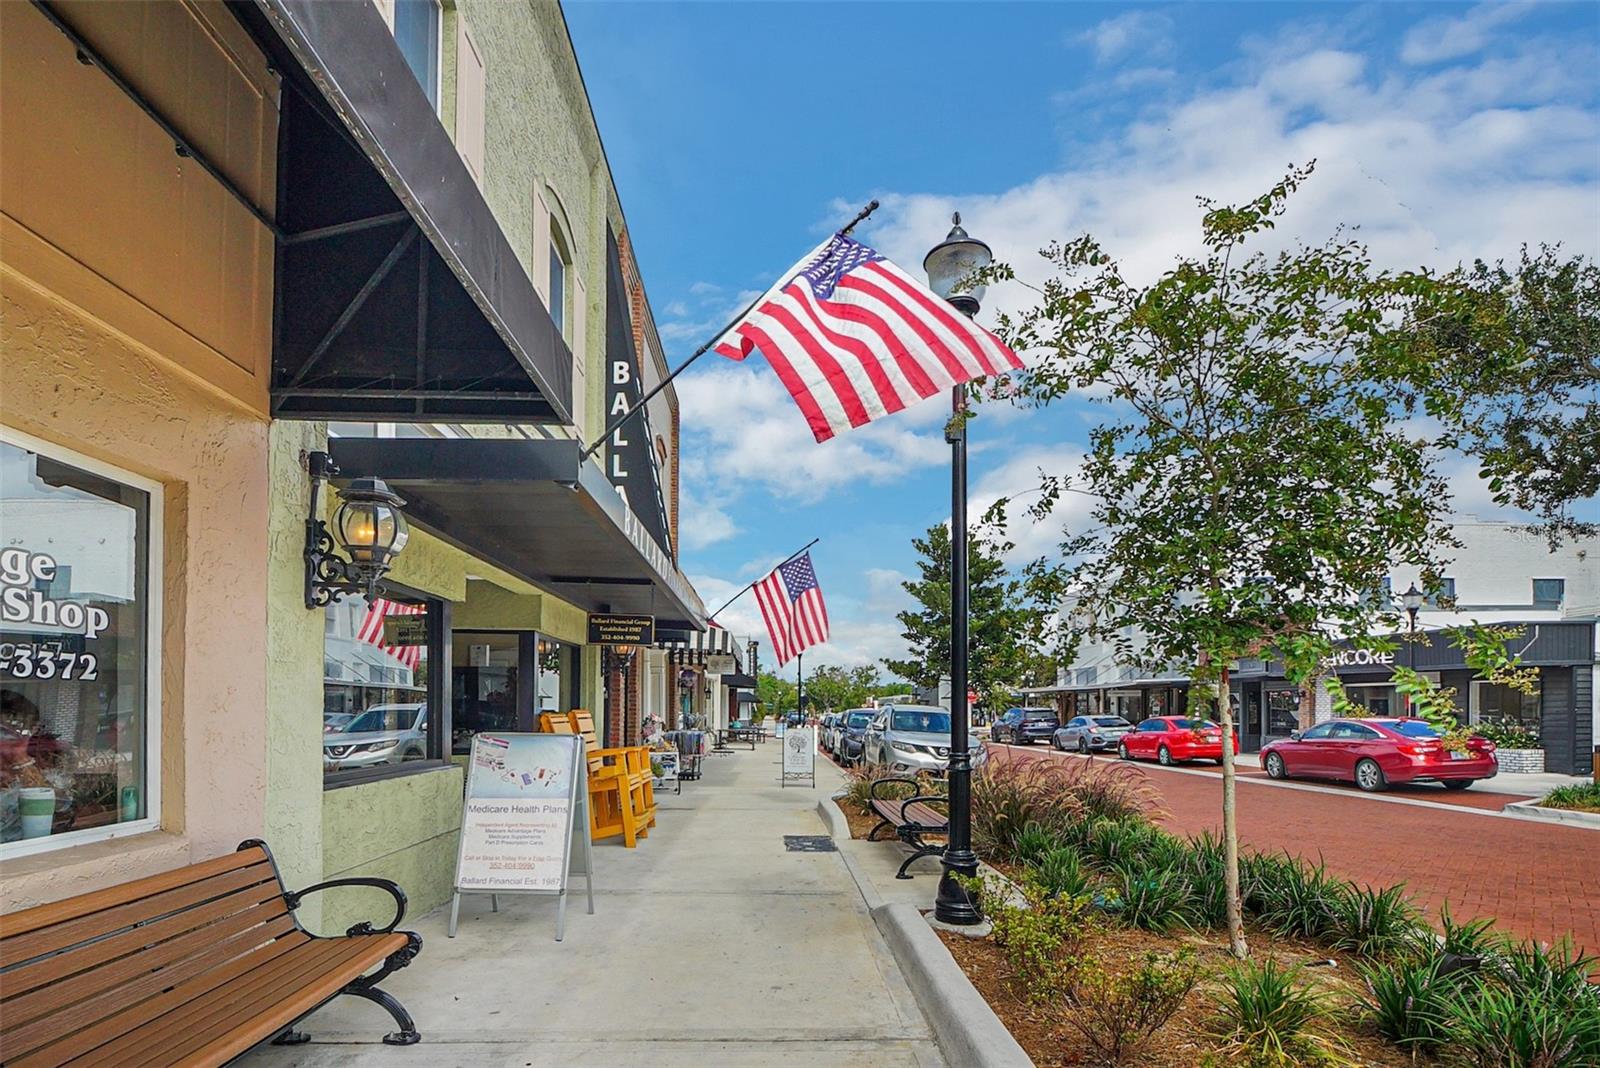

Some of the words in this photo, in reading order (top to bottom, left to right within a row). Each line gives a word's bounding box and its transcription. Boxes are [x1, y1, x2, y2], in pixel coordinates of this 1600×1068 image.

[0, 548, 56, 586] ge
[2, 587, 110, 639] Shop
[468, 805, 509, 813] Medicare
[511, 805, 540, 813] Health
[542, 805, 568, 814] Plans
[461, 877, 487, 885] Ballard
[488, 877, 523, 885] Financial
